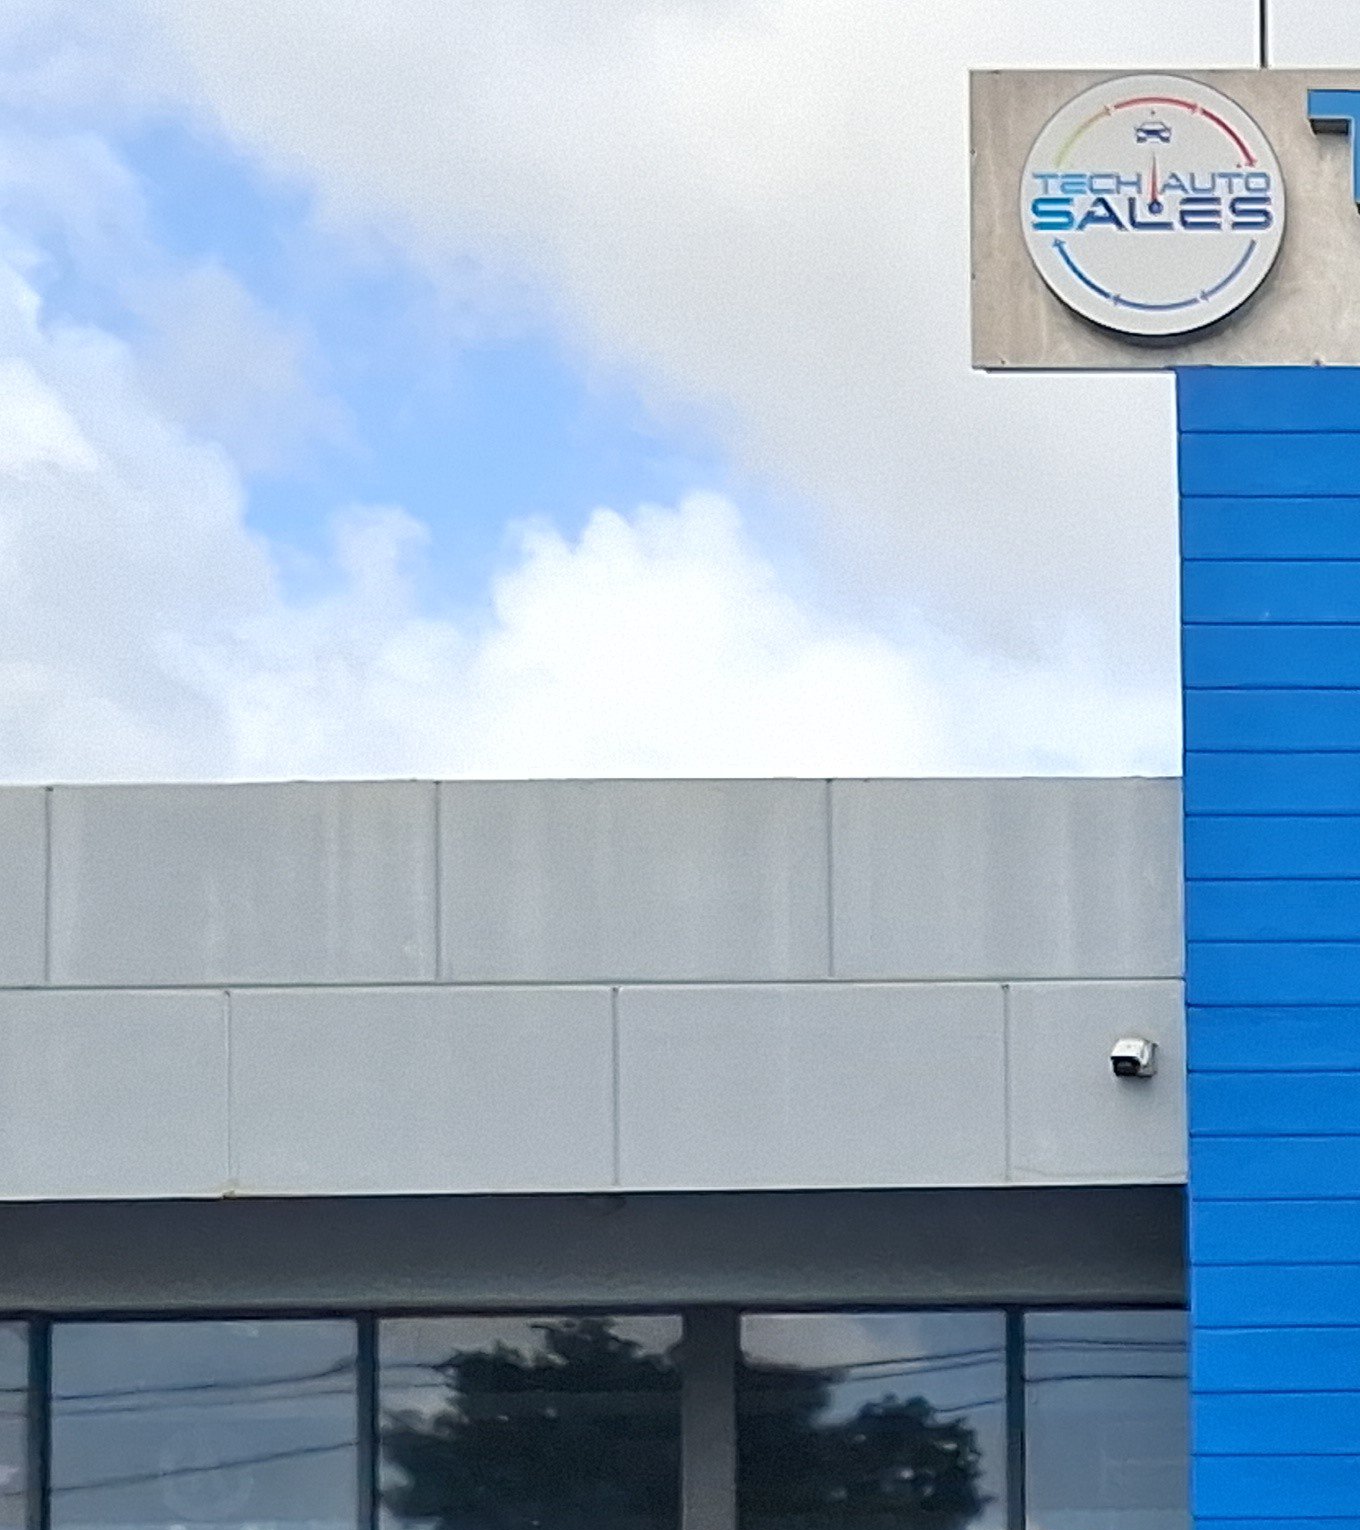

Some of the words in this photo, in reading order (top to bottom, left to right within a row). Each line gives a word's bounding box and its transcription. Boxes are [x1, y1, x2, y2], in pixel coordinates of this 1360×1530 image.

[1032, 171, 1142, 195] TECH
[1160, 171, 1272, 195] AUTO
[1031, 196, 1273, 231] SALES
